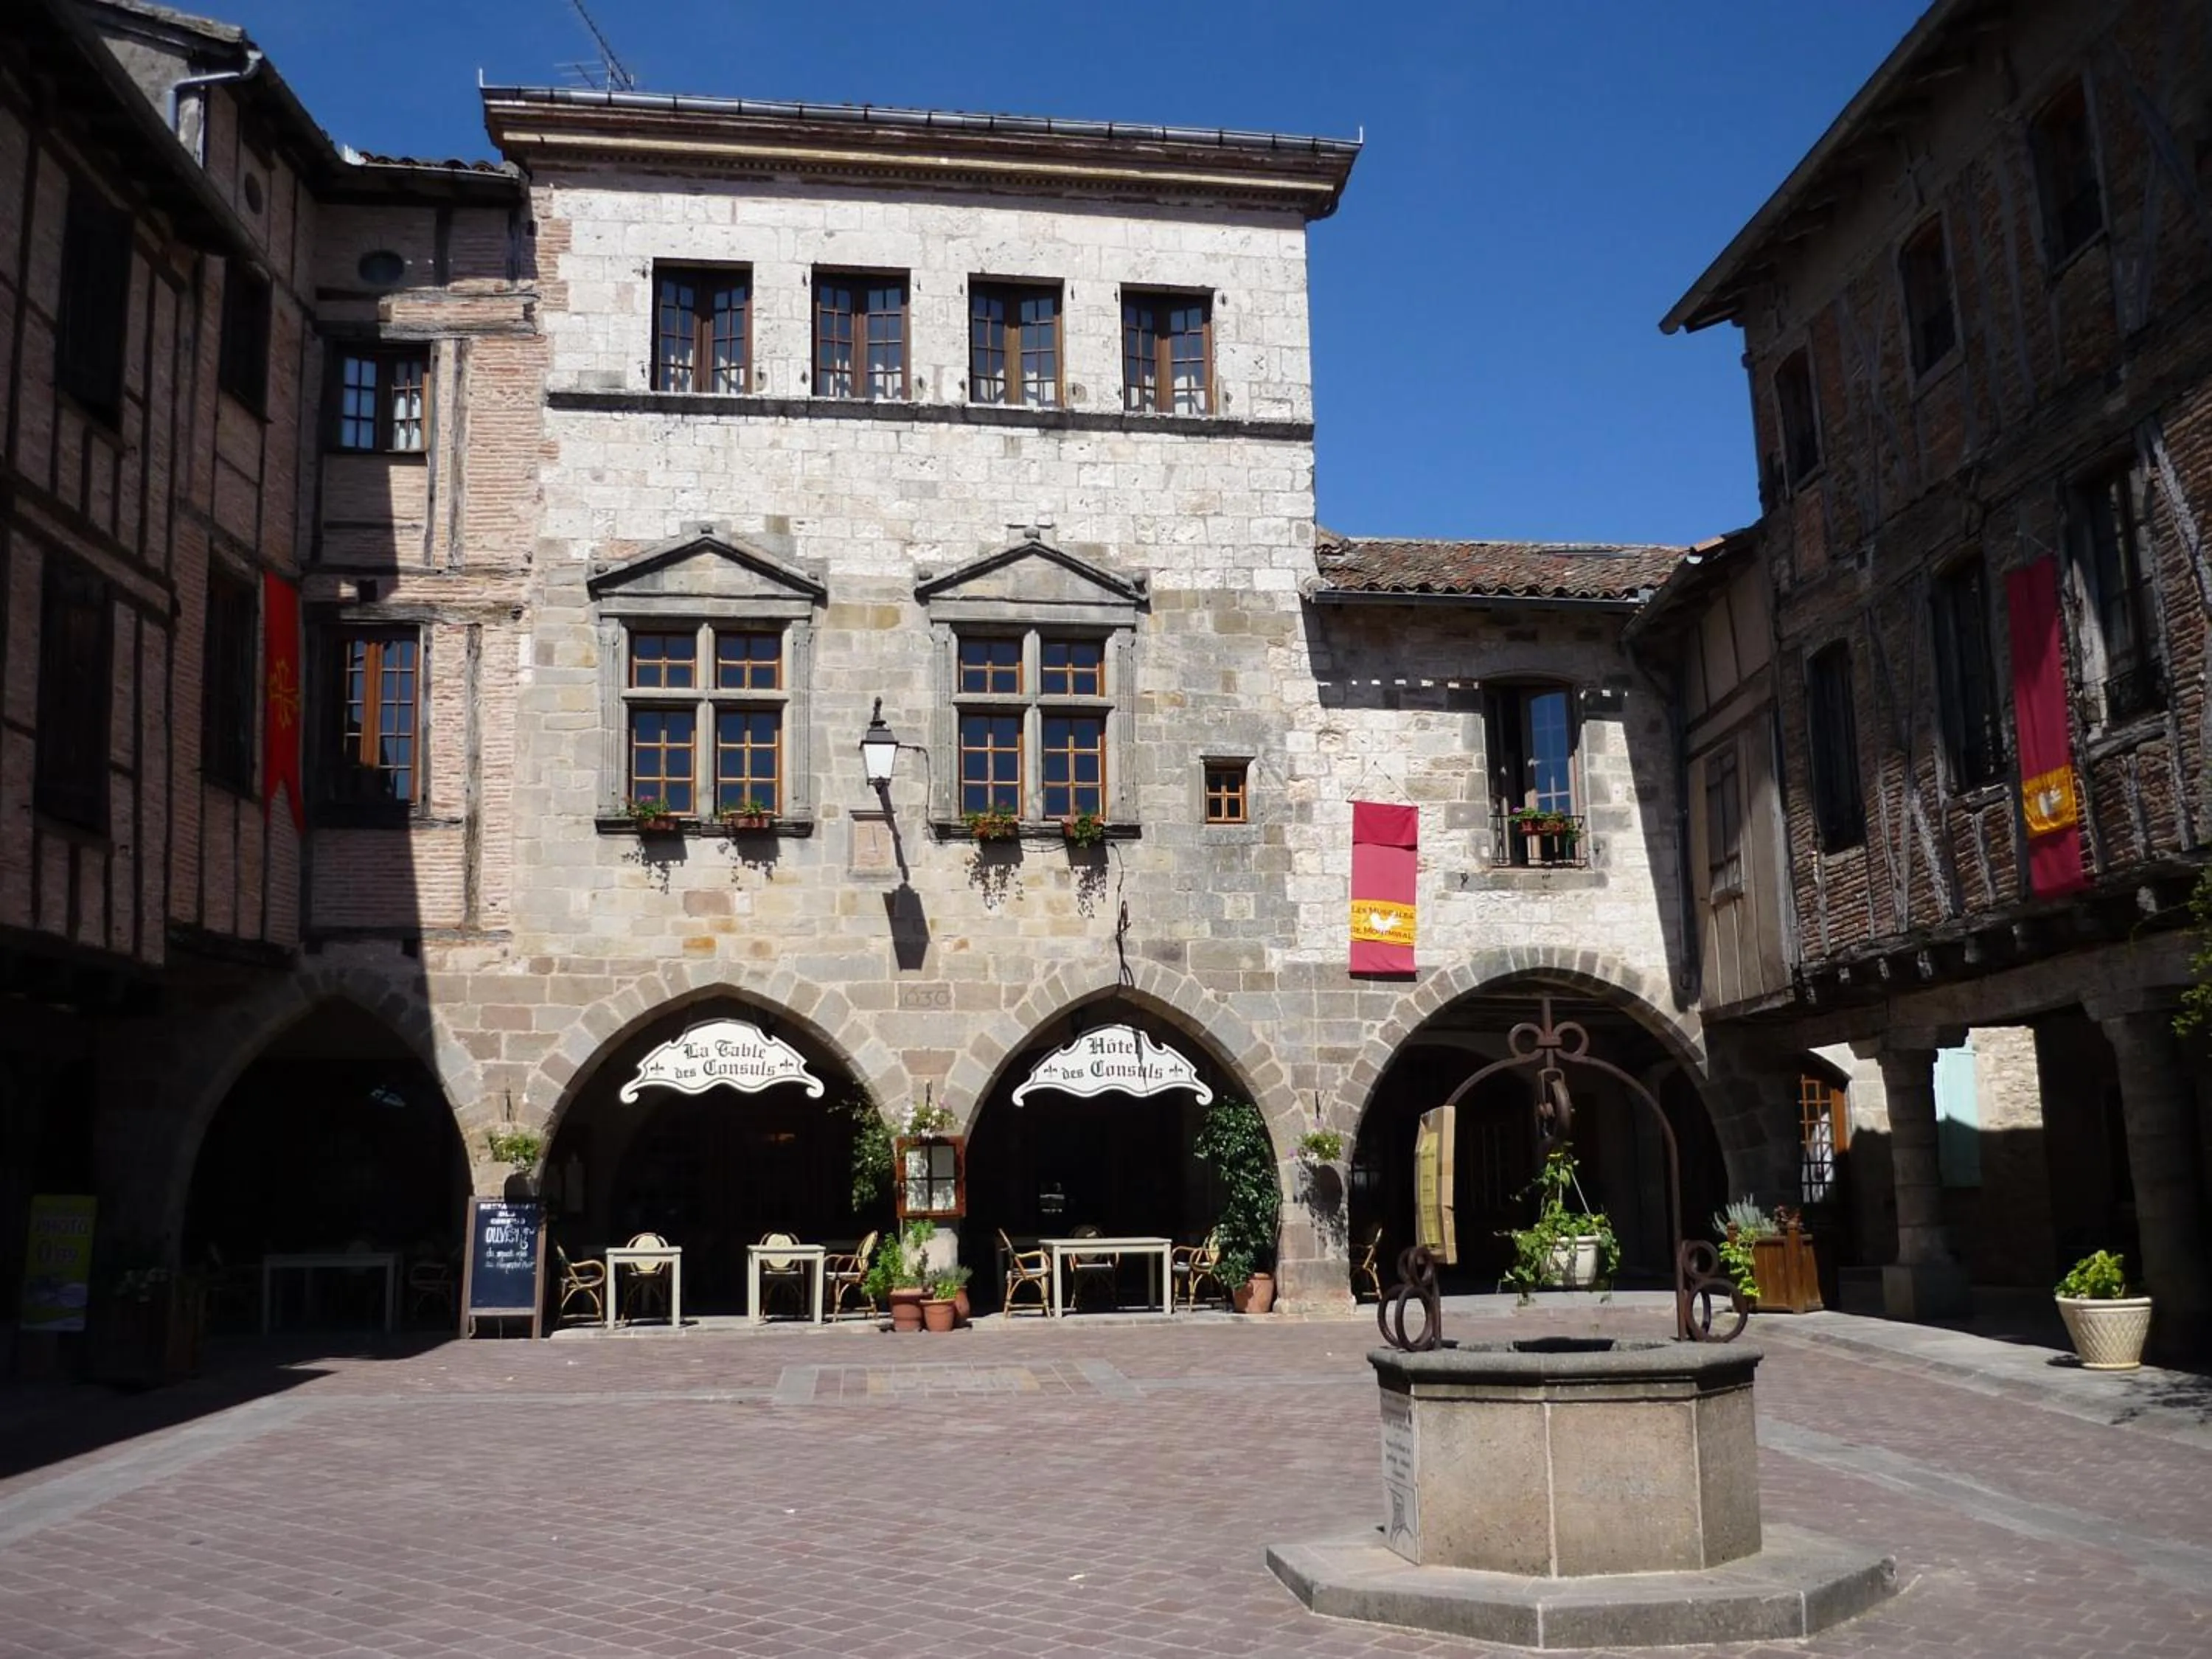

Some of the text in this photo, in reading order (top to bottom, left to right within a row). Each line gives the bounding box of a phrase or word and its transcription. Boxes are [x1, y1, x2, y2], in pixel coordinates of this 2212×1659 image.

[683, 1039, 767, 1060] La Table
[1086, 1037, 1138, 1055] Hôtel
[674, 1059, 776, 1079] des Consuls
[1062, 1060, 1163, 1080] des Consuls
